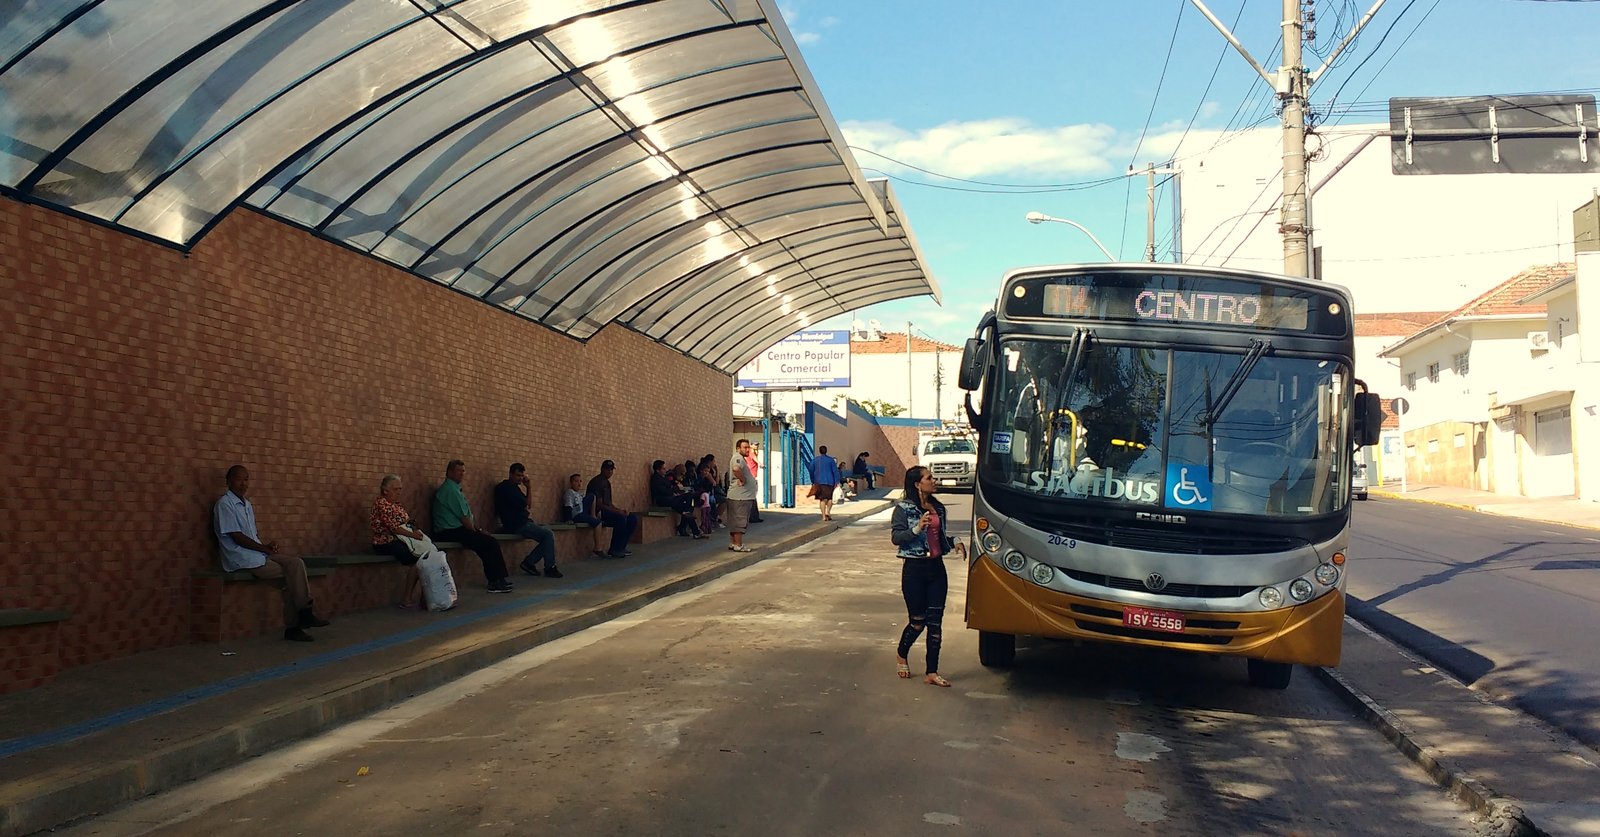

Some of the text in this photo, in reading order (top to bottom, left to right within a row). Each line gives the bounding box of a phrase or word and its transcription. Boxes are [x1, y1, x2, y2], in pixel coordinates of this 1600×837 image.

[1135, 291, 1262, 325] CENTRO
[767, 350, 845, 361] Centro Popular
[780, 363, 831, 373] Comercial
[1048, 535, 1076, 549] 2049
